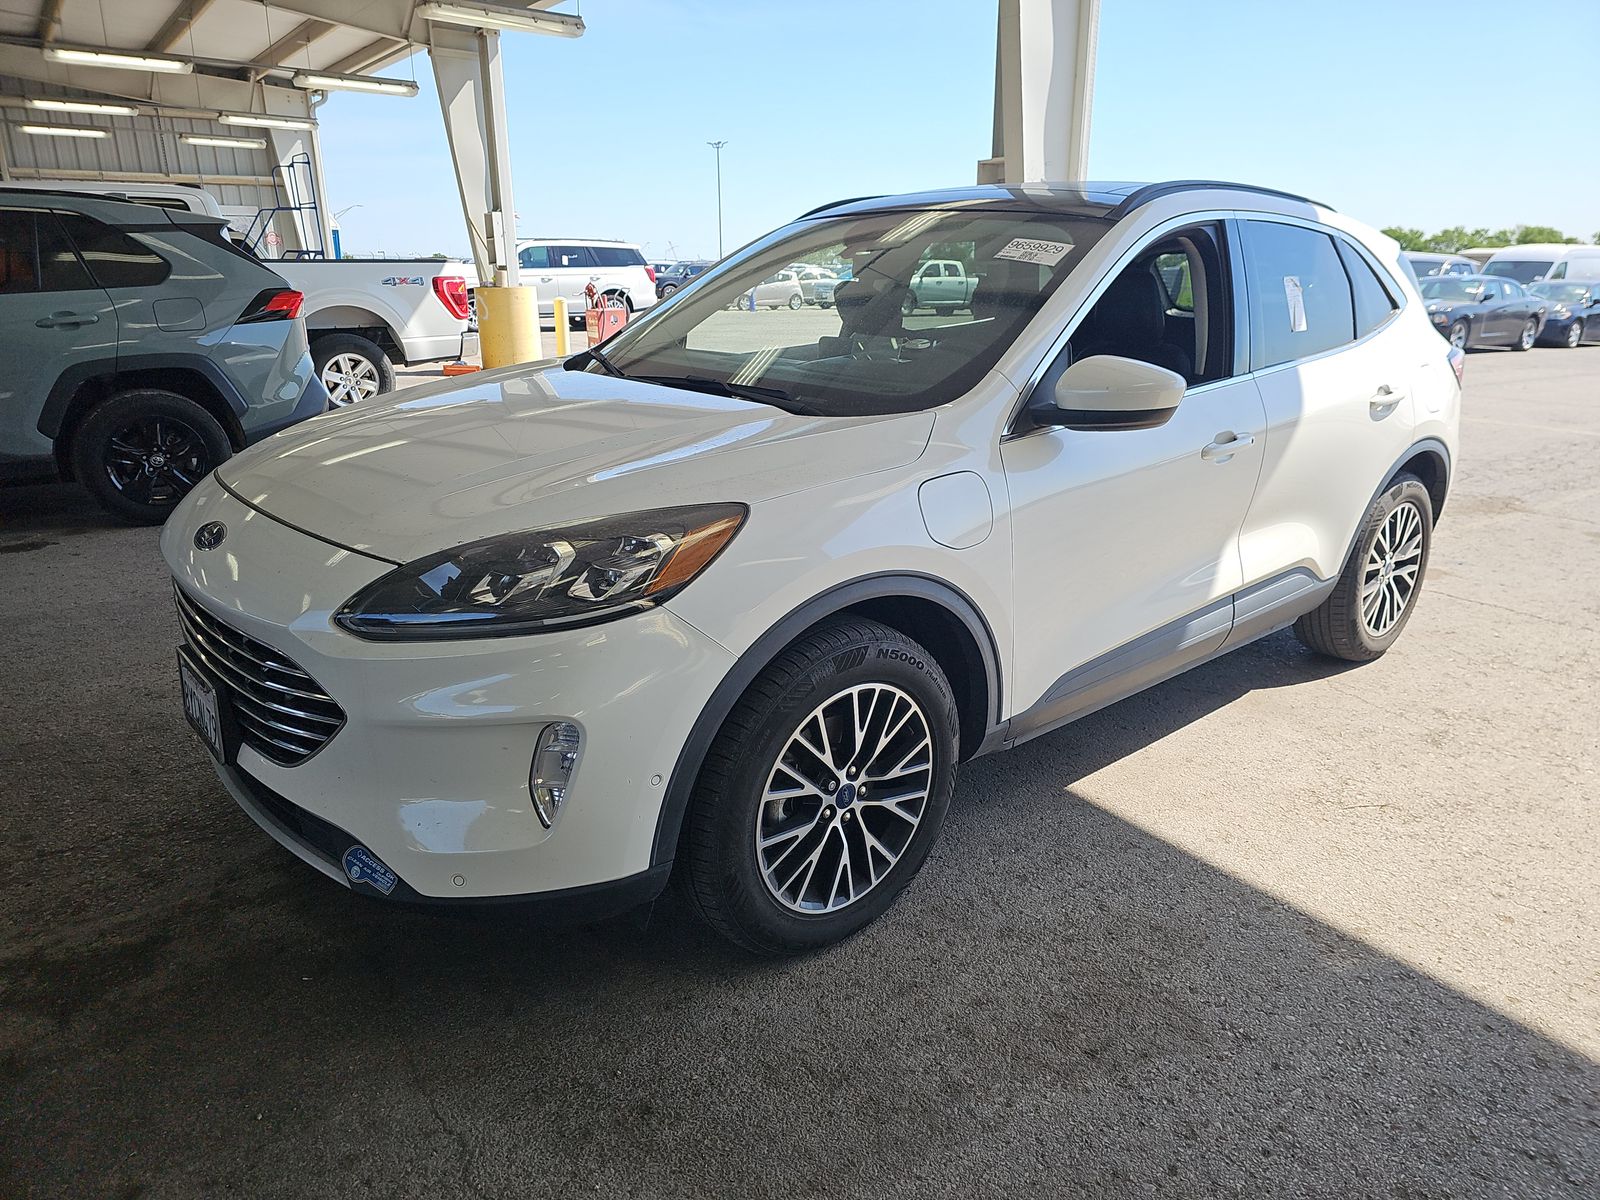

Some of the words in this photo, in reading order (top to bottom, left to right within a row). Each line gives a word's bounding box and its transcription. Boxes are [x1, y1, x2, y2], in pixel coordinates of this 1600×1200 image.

[1008, 241, 1064, 254] 9659929
[877, 648, 924, 670] N5000
[361, 855, 385, 873] ACCESS
